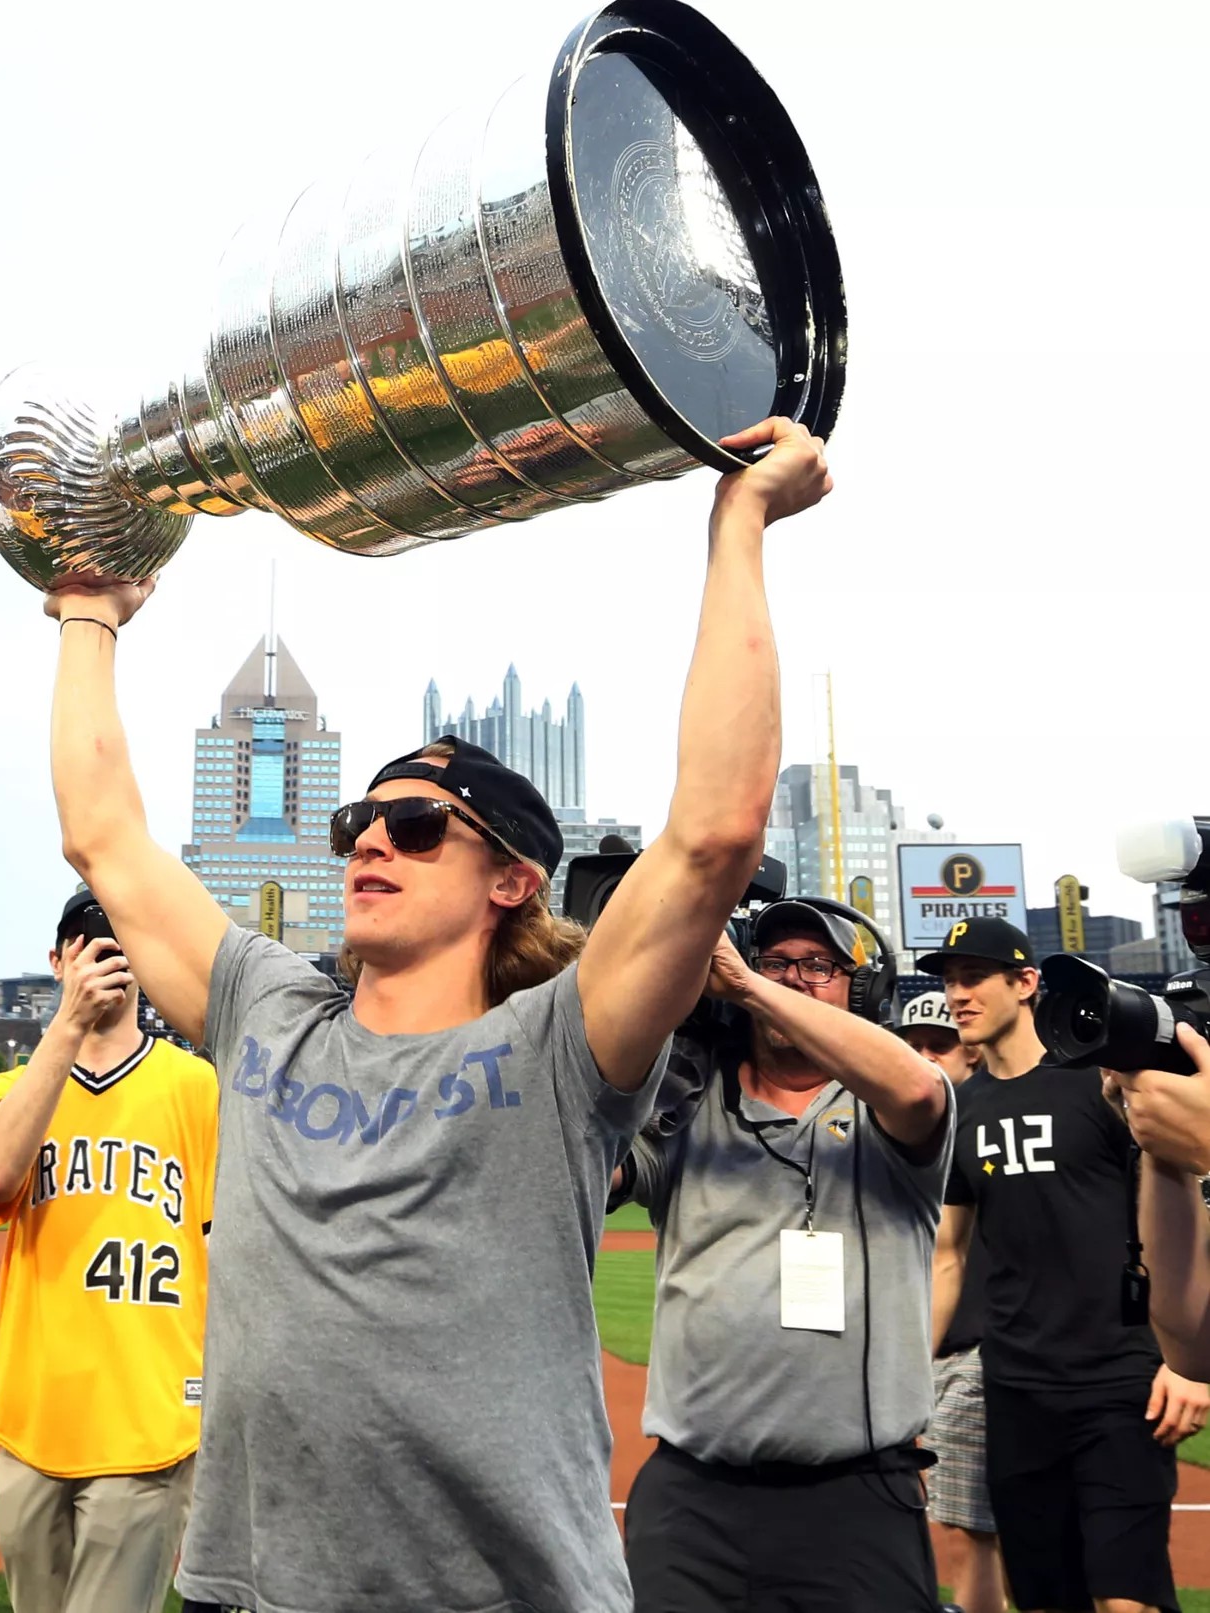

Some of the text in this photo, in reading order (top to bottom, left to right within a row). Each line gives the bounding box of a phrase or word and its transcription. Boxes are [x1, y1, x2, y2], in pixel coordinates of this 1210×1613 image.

[264, 887, 275, 921] Health
[920, 902, 1009, 918] PIRATES
[947, 921, 968, 947] P
[1166, 980, 1193, 991] Nikon
[908, 999, 951, 1023] PGH
[84, 1239, 181, 1306] 412
